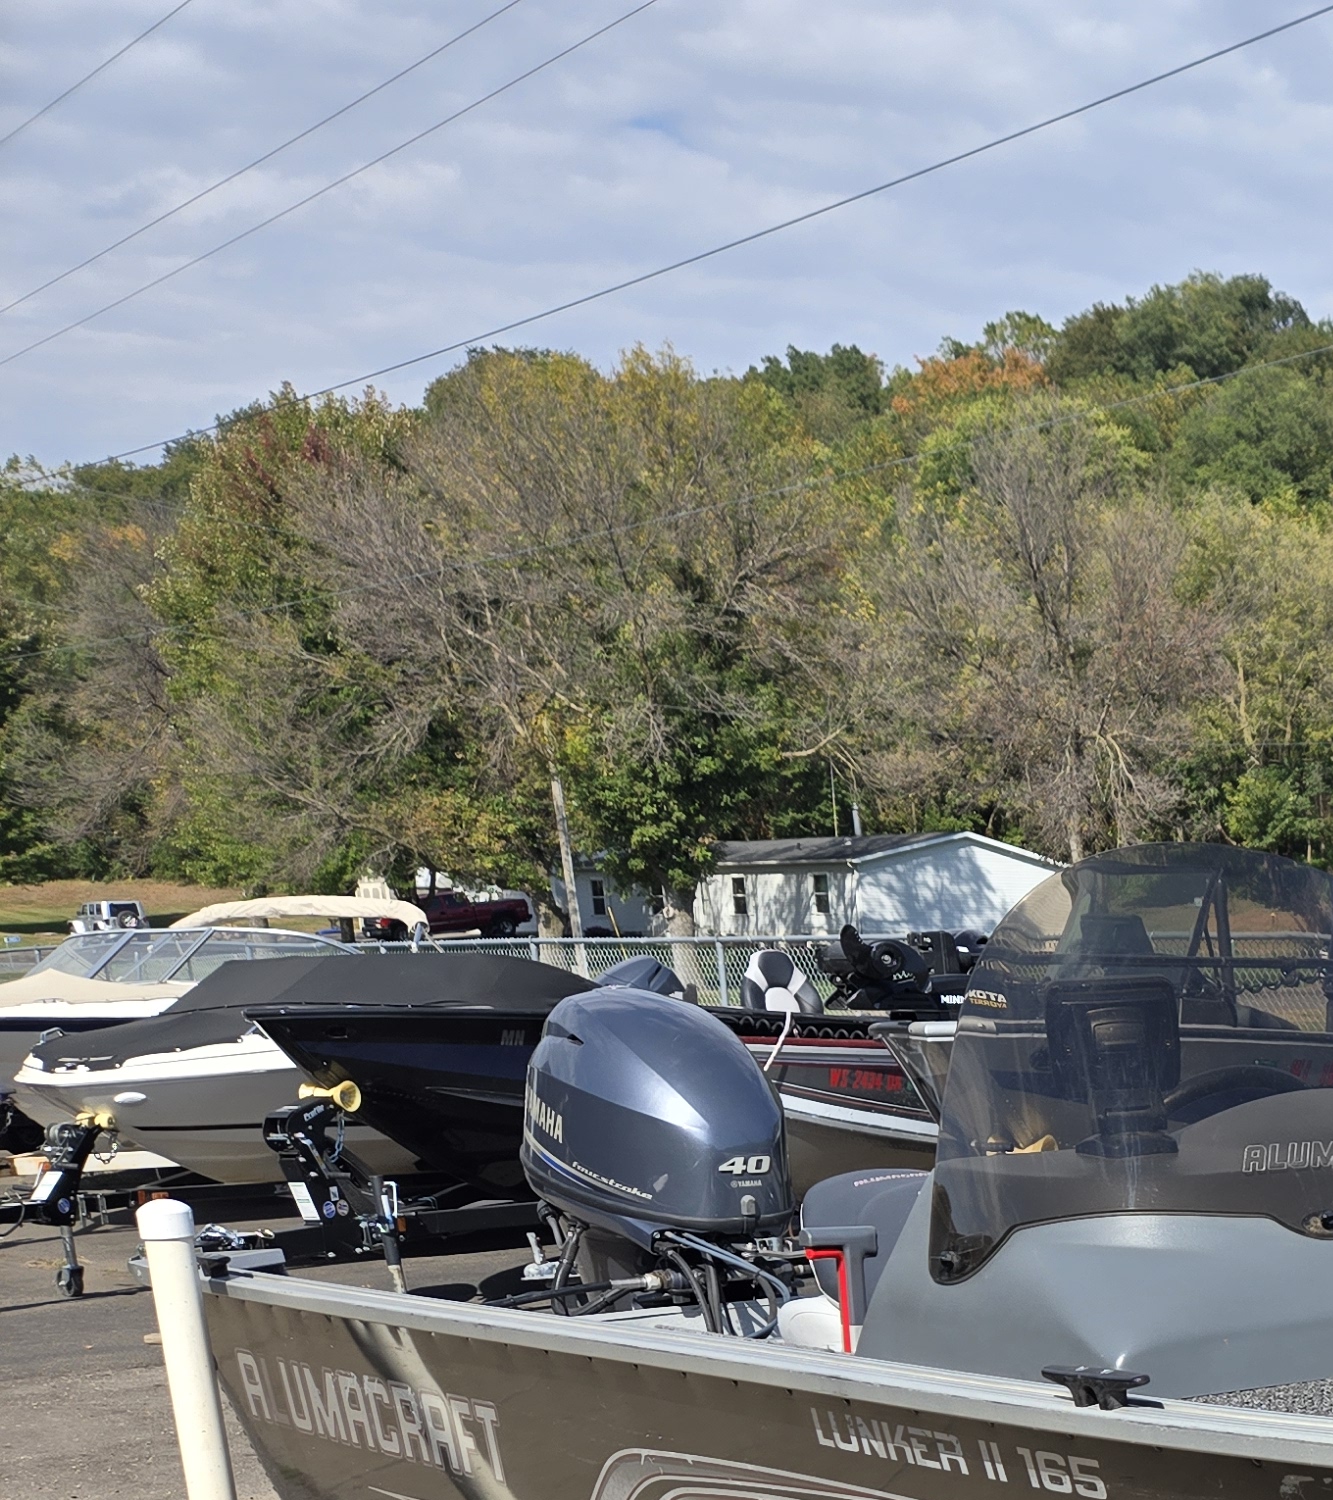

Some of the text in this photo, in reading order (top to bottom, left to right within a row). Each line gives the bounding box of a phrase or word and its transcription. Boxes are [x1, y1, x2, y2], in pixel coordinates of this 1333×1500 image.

[968, 989, 1007, 1003] KOTA
[718, 1155, 771, 1175] 40
[737, 1179, 763, 1188] YAMAHA
[810, 1407, 1108, 1500] LUNKER II 165
